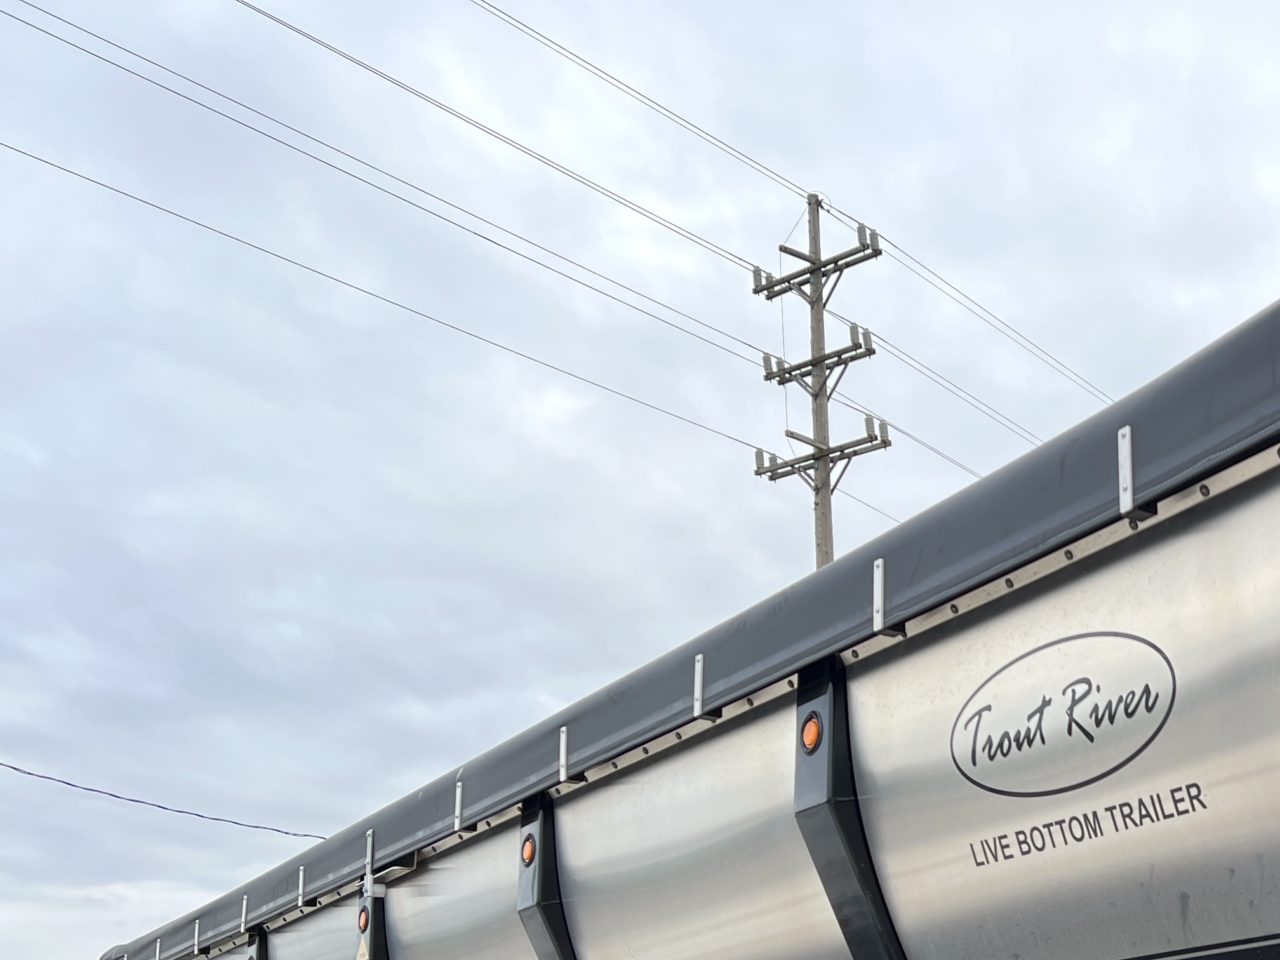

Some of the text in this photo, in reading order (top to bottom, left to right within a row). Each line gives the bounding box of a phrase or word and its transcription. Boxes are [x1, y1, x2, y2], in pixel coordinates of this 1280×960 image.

[964, 677, 1159, 767] Trout River
[970, 782, 1208, 867] LIVE BOTTOM TRAILER
